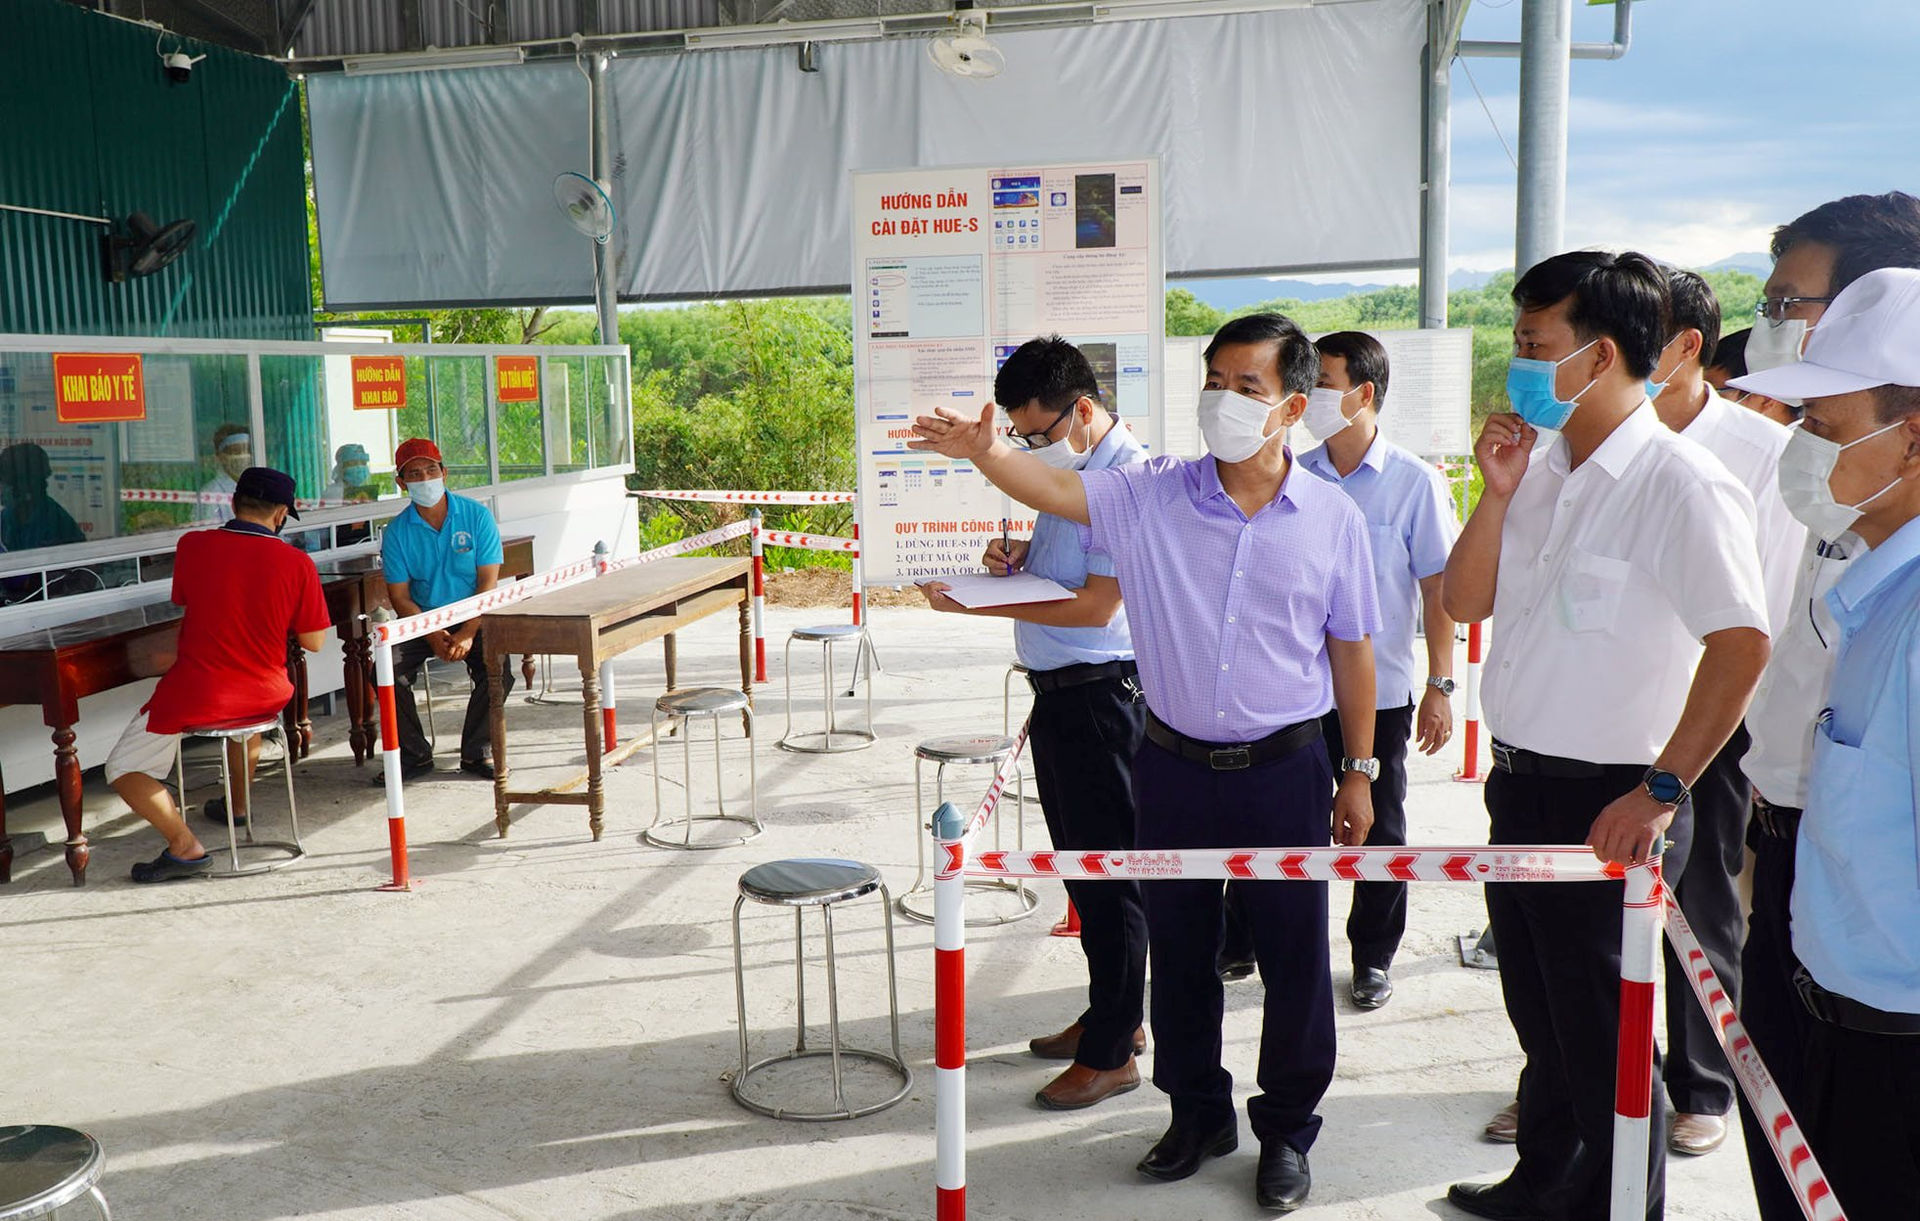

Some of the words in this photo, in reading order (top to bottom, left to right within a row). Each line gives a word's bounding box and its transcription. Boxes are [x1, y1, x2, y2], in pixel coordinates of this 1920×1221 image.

[881, 192, 932, 210] HƯỚNG
[936, 187, 968, 208] DẪN
[872, 218, 896, 236] CÀI
[901, 217, 929, 238] ĐẶT
[933, 217, 979, 234] HUE-S
[62, 375, 89, 402] KHAI
[90, 368, 112, 402] BÁO
[112, 375, 120, 401] Y
[121, 364, 136, 401] TẾ
[361, 390, 380, 404] KHAI
[381, 387, 399, 403] BÁO
[895, 522, 918, 534] QUY
[922, 519, 958, 534] TRÌNH
[961, 519, 994, 533] CÔNG
[896, 541, 903, 549] 1.
[905, 538, 934, 549] DÙNG
[937, 539, 967, 549] HUE-S
[895, 555, 904, 563] 2.
[905, 553, 935, 563] QUÉT
[954, 553, 970, 562] QR
[896, 569, 904, 577] 3.
[907, 566, 938, 576] TRÌNH
